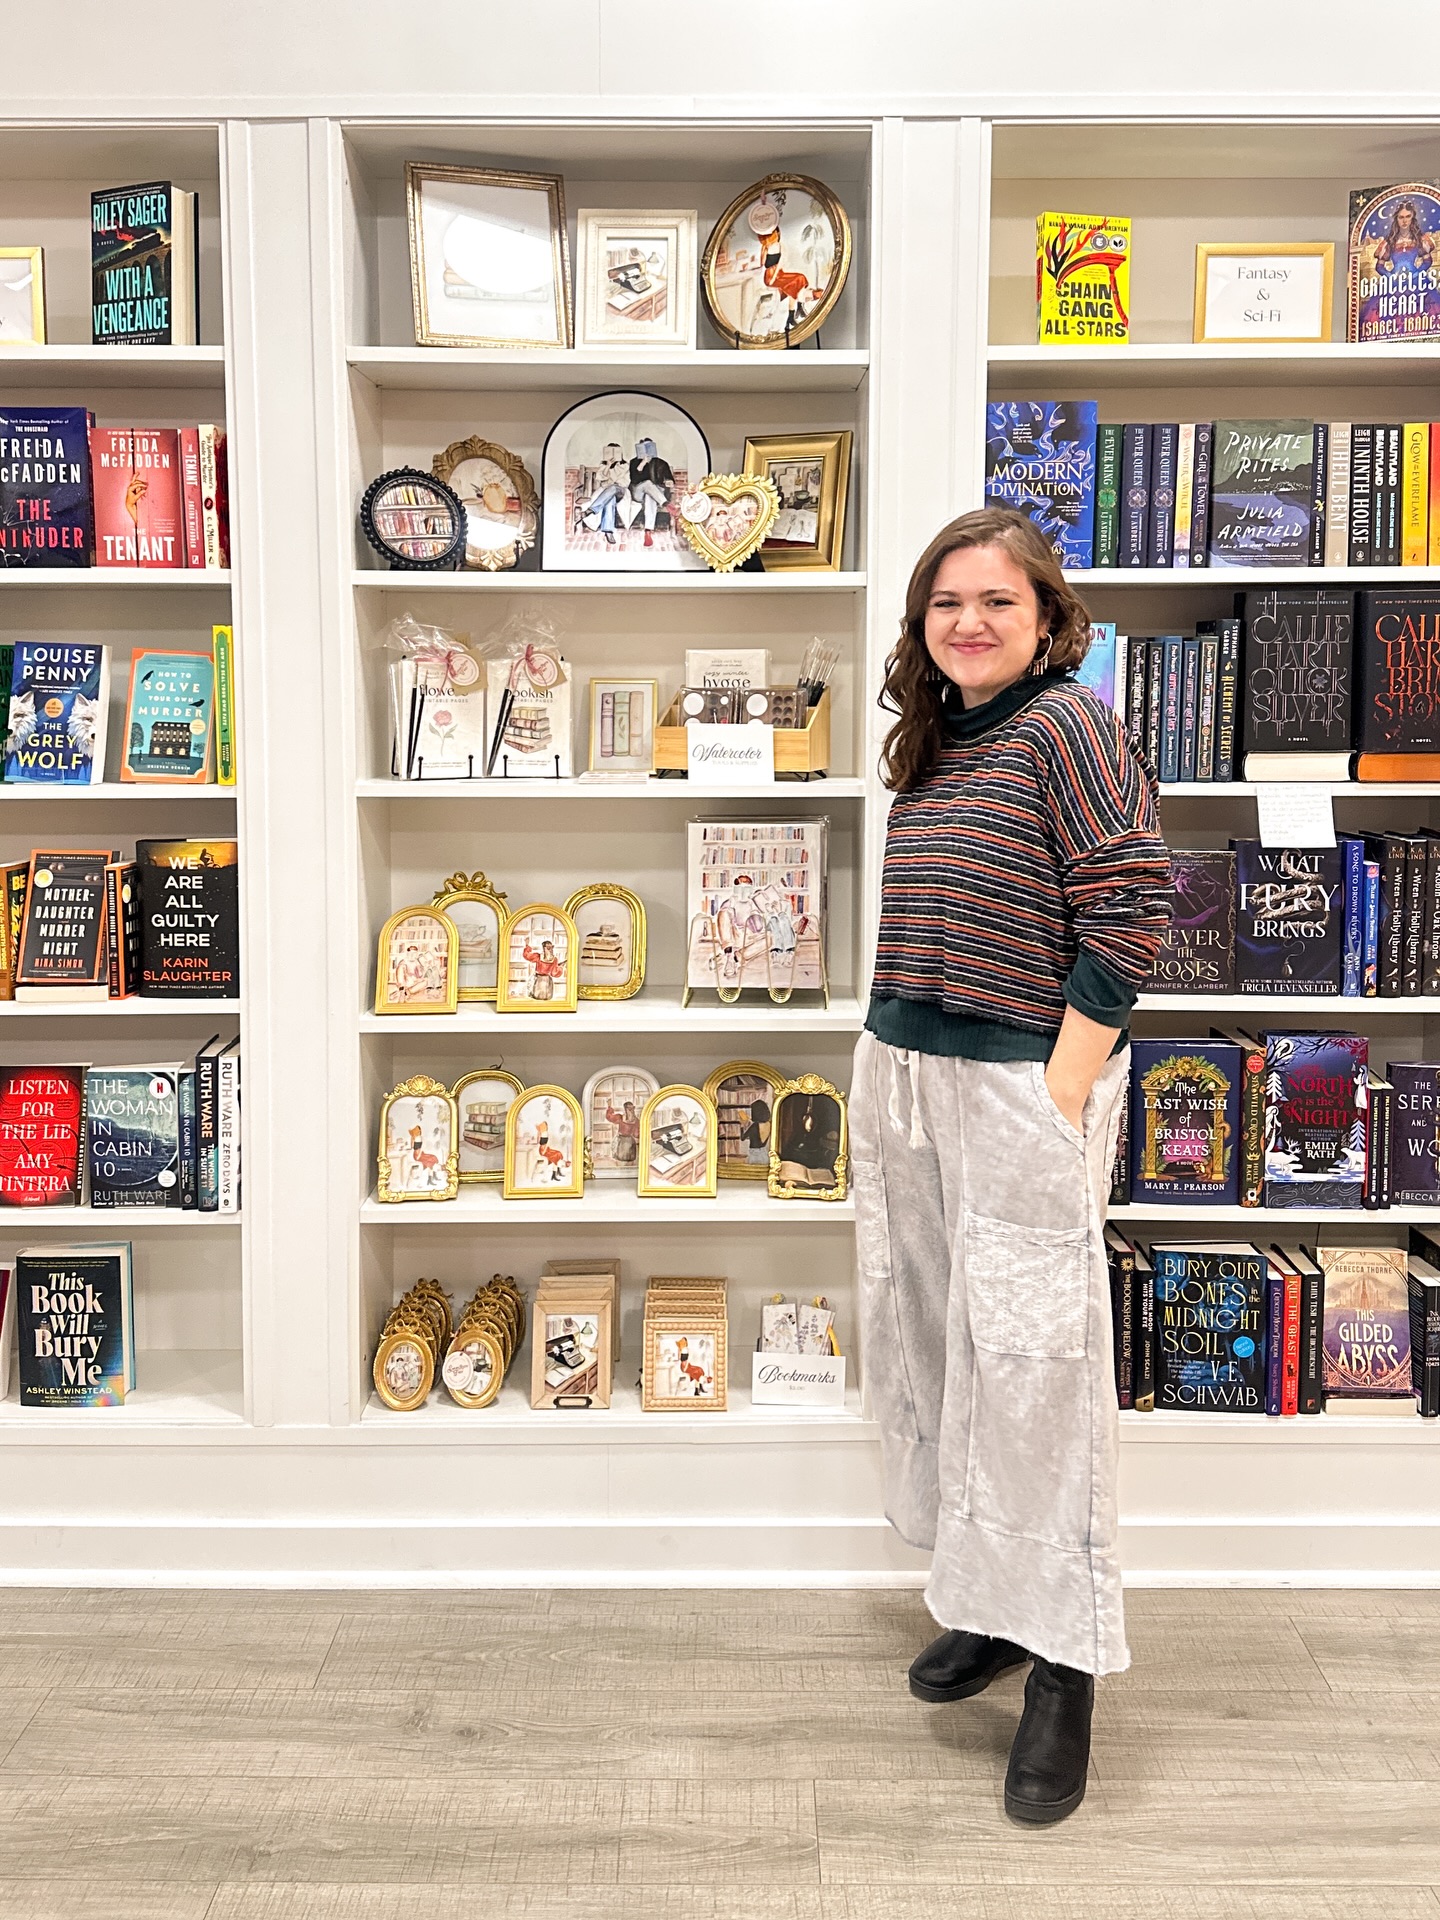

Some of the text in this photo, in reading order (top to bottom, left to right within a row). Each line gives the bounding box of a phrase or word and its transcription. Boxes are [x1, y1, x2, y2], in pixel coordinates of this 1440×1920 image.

[93, 194, 167, 232] RILEY SAGER
[105, 265, 154, 301] WITH A
[1237, 266, 1292, 283] Fantasy
[1256, 288, 1270, 301] &
[1058, 300, 1114, 319] GANG
[1379, 292, 1428, 318] HEART
[93, 297, 169, 336] VENGEANCE
[1243, 309, 1282, 323] Sci-Fi
[1045, 319, 1127, 338] ALL-STARS
[0, 438, 65, 459] FREIDA
[111, 437, 158, 453] FREIDA
[1103, 437, 1114, 463] EVER
[1223, 431, 1303, 454] PRIVATE
[101, 453, 170, 468] McFADDEN
[1235, 457, 1290, 479] RITES
[0, 463, 82, 484] cFADDEN
[991, 462, 1083, 481] MODERN
[1103, 464, 1114, 485] KING
[1410, 431, 1423, 527] GLOW EVERFLAME
[991, 482, 1083, 497] DIVINATION
[1331, 451, 1349, 532] HELL BENT
[1352, 448, 1370, 544] NINTH HOUSE
[16, 499, 52, 521] THE
[1237, 502, 1285, 520] JULIA
[0, 526, 84, 549] NTRUDER
[1100, 521, 1108, 552] ANDREWS
[1218, 522, 1304, 540] ARMFIELD
[103, 535, 175, 561] TENANT
[1251, 613, 1350, 644] CALLIE
[22, 646, 95, 665] LOUISE
[1263, 641, 1341, 669] HART
[22, 665, 92, 683] PENNY
[1249, 667, 1350, 695] QUICK
[144, 681, 200, 693] SOLVE
[138, 706, 203, 718] MURDER
[1252, 693, 1348, 731] SILVER
[43, 722, 62, 731] THE
[28, 733, 77, 749] GREY
[17, 750, 84, 770] WOLF
[692, 742, 763, 762] Watercolor
[169, 856, 198, 870] WE
[1258, 854, 1325, 879] WHAT
[164, 875, 204, 890] ARE
[1352, 875, 1359, 884] TO
[44, 887, 95, 902] MOTHER-
[165, 895, 203, 909] ALL
[1239, 883, 1340, 912] FURY
[1351, 886, 1359, 914] DROWN
[35, 905, 95, 920] DAUGHTER
[151, 913, 220, 928] GUILTY
[1388, 874, 1402, 964] Wren Holly Library
[39, 924, 85, 938] MURDER
[1252, 919, 1327, 938] BRINGS
[1350, 916, 1358, 940] RIVERS
[42, 942, 79, 956] NIGHT
[160, 933, 211, 947] HERE
[34, 958, 84, 968] NINA SIMON
[163, 957, 209, 968] KARIN
[1153, 960, 1221, 982] ROSES
[143, 970, 232, 982] SLAUGHTER
[1239, 983, 1338, 994] TRICIA LEVENSELLER
[8, 1079, 70, 1095] LISTEN
[91, 1078, 129, 1095] THE
[1175, 1082, 1197, 1097] The
[1287, 1076, 1353, 1098] NORTH
[1414, 1081, 1431, 1090] THE
[20, 1101, 55, 1117] FOR
[91, 1099, 173, 1116] WOMAN
[200, 1062, 213, 1138] RUTH WARE
[1143, 1098, 1228, 1111] LAST WISH
[1305, 1097, 1334, 1107] is the
[1179, 1112, 1192, 1128] of
[1286, 1104, 1351, 1128] NIGHT
[1, 1124, 71, 1139] THE LIE
[92, 1120, 112, 1136] IN
[222, 1062, 232, 1194] RUTH WARE ZERO DAYS
[1154, 1128, 1218, 1141] BRISTOL
[93, 1141, 152, 1157] CABIN
[1161, 1144, 1210, 1156] KEATS
[1304, 1141, 1338, 1151] EMILY
[1306, 1150, 1335, 1159] RATH
[14, 1153, 54, 1169] AMY
[94, 1161, 116, 1177] 10
[93, 1190, 172, 1201] RUTH WARE
[1144, 1181, 1225, 1191] MARY E. PEARSON
[1394, 1191, 1433, 1201] REBECCA
[1164, 1258, 1260, 1280] BURY OUR
[1335, 1265, 1393, 1275] REBECCA THORNE
[48, 1272, 85, 1291] This
[1251, 1287, 1258, 1295] in
[31, 1284, 104, 1314] Book
[1164, 1280, 1246, 1306] BONES
[1249, 1294, 1260, 1303] the
[1123, 1284, 1132, 1330] BOOKSHOP
[1355, 1309, 1375, 1321] THIS
[49, 1314, 89, 1335] Will
[1163, 1306, 1260, 1330] MIDNIGHT
[1287, 1280, 1298, 1357] KILL THE BEAST
[1338, 1322, 1393, 1344] GILDED
[34, 1328, 103, 1363] Bury
[1123, 1330, 1131, 1359] BELOW
[1163, 1330, 1224, 1356] SOIL
[1337, 1344, 1399, 1375] ABYSS
[60, 1357, 103, 1386] Me
[758, 1364, 837, 1384] Bookmarks
[26, 1386, 113, 1395] ASHLEY WINSTEAD
[1162, 1383, 1259, 1407] SCHWAB
